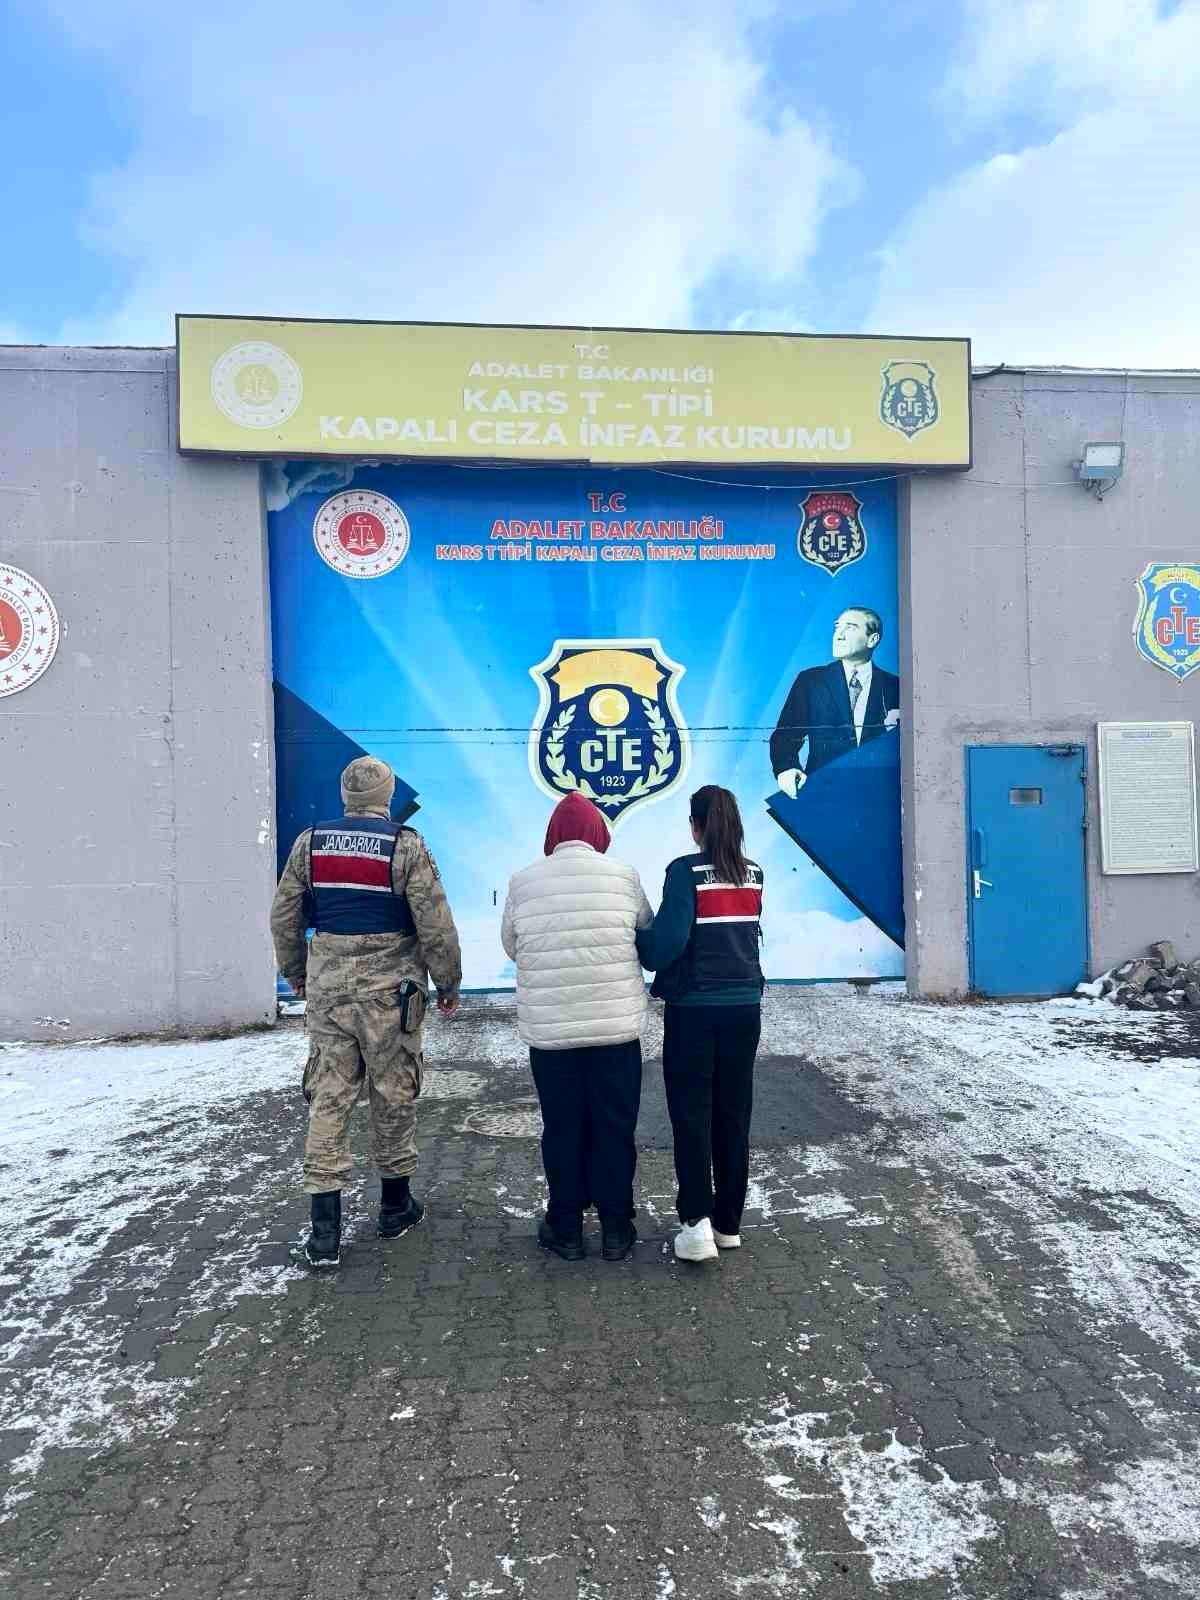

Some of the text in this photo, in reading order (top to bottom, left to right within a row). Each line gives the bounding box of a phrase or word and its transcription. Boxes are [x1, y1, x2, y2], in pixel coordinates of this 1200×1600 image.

[468, 362, 714, 384] ADALET BAKANLIĞI
[463, 388, 569, 414] KARS
[579, 390, 607, 416] T
[642, 387, 713, 417] TİPİ
[319, 415, 852, 450] KAPALI CEZA İNFAZ KURUMU
[588, 492, 627, 513] T.C
[490, 515, 724, 541] ADALET BAKANLIĞI
[435, 541, 777, 561] KARS T TİPİ KAPALI CEZA İNFAZ KURUMU
[819, 530, 847, 551] CTE
[1157, 606, 1200, 646] CTE
[581, 728, 642, 773] CTE
[600, 775, 626, 787] 1923
[322, 835, 381, 855] JANDARMA
